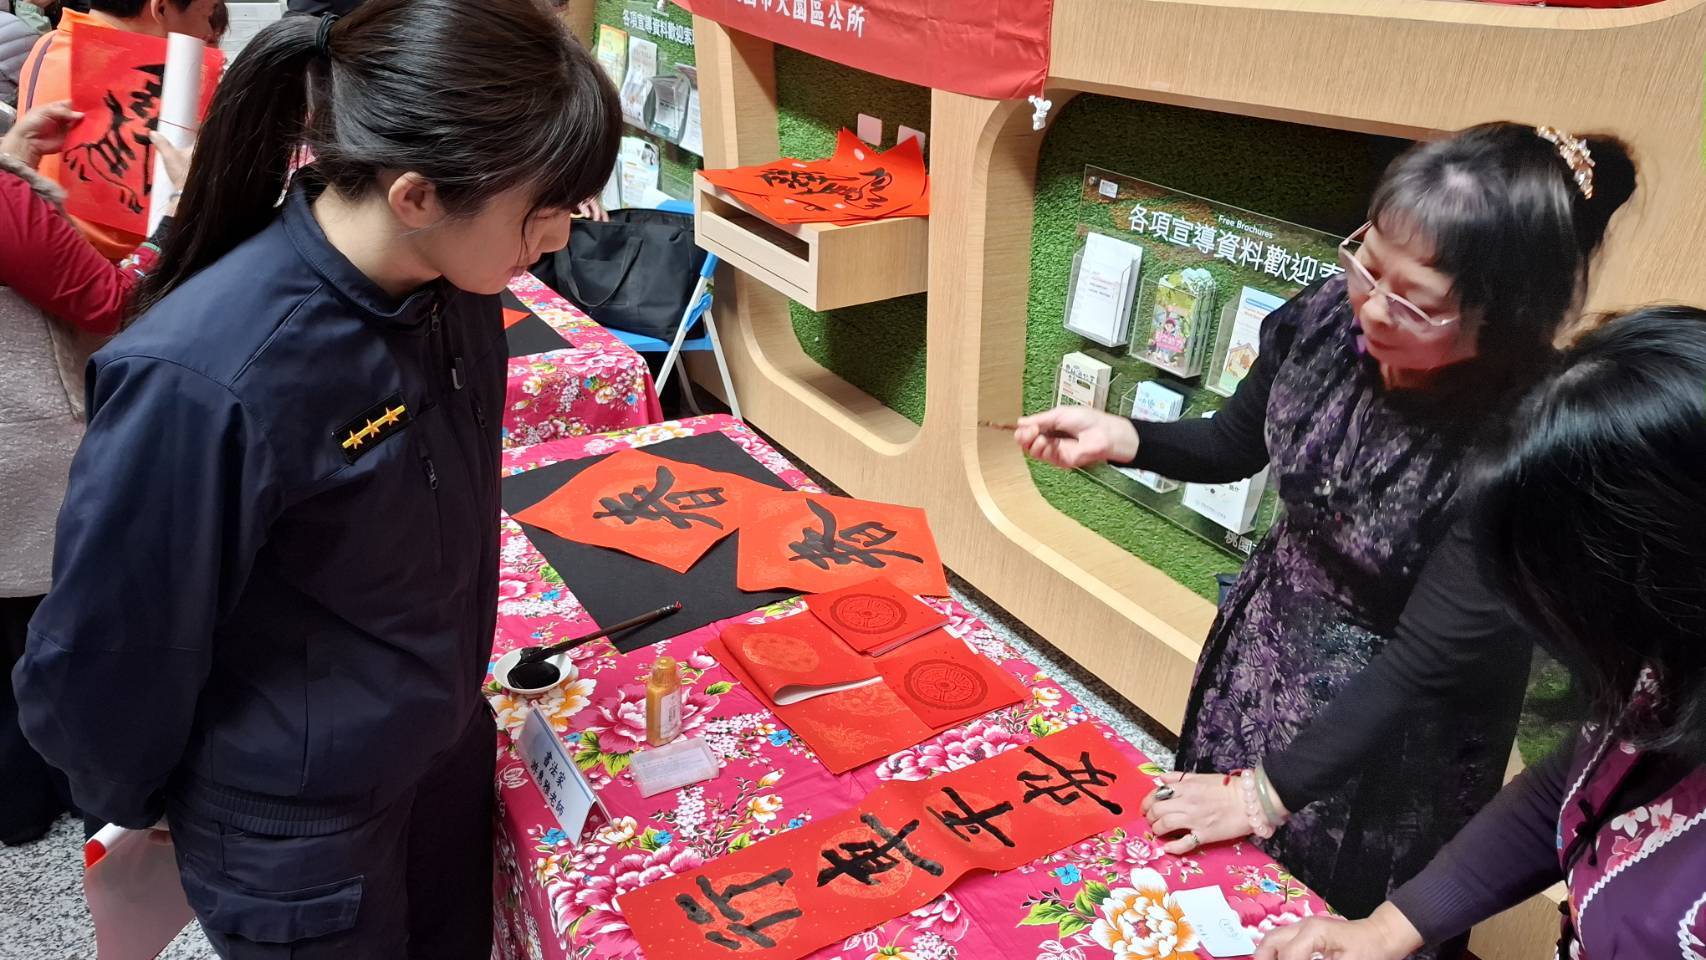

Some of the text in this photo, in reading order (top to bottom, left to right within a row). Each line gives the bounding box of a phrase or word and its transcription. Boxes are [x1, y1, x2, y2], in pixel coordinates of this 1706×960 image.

[1218, 214, 1274, 239] Free Brochures
[593, 465, 725, 530] 春
[788, 498, 924, 570] 春
[675, 745, 1124, 950] 行車平安
